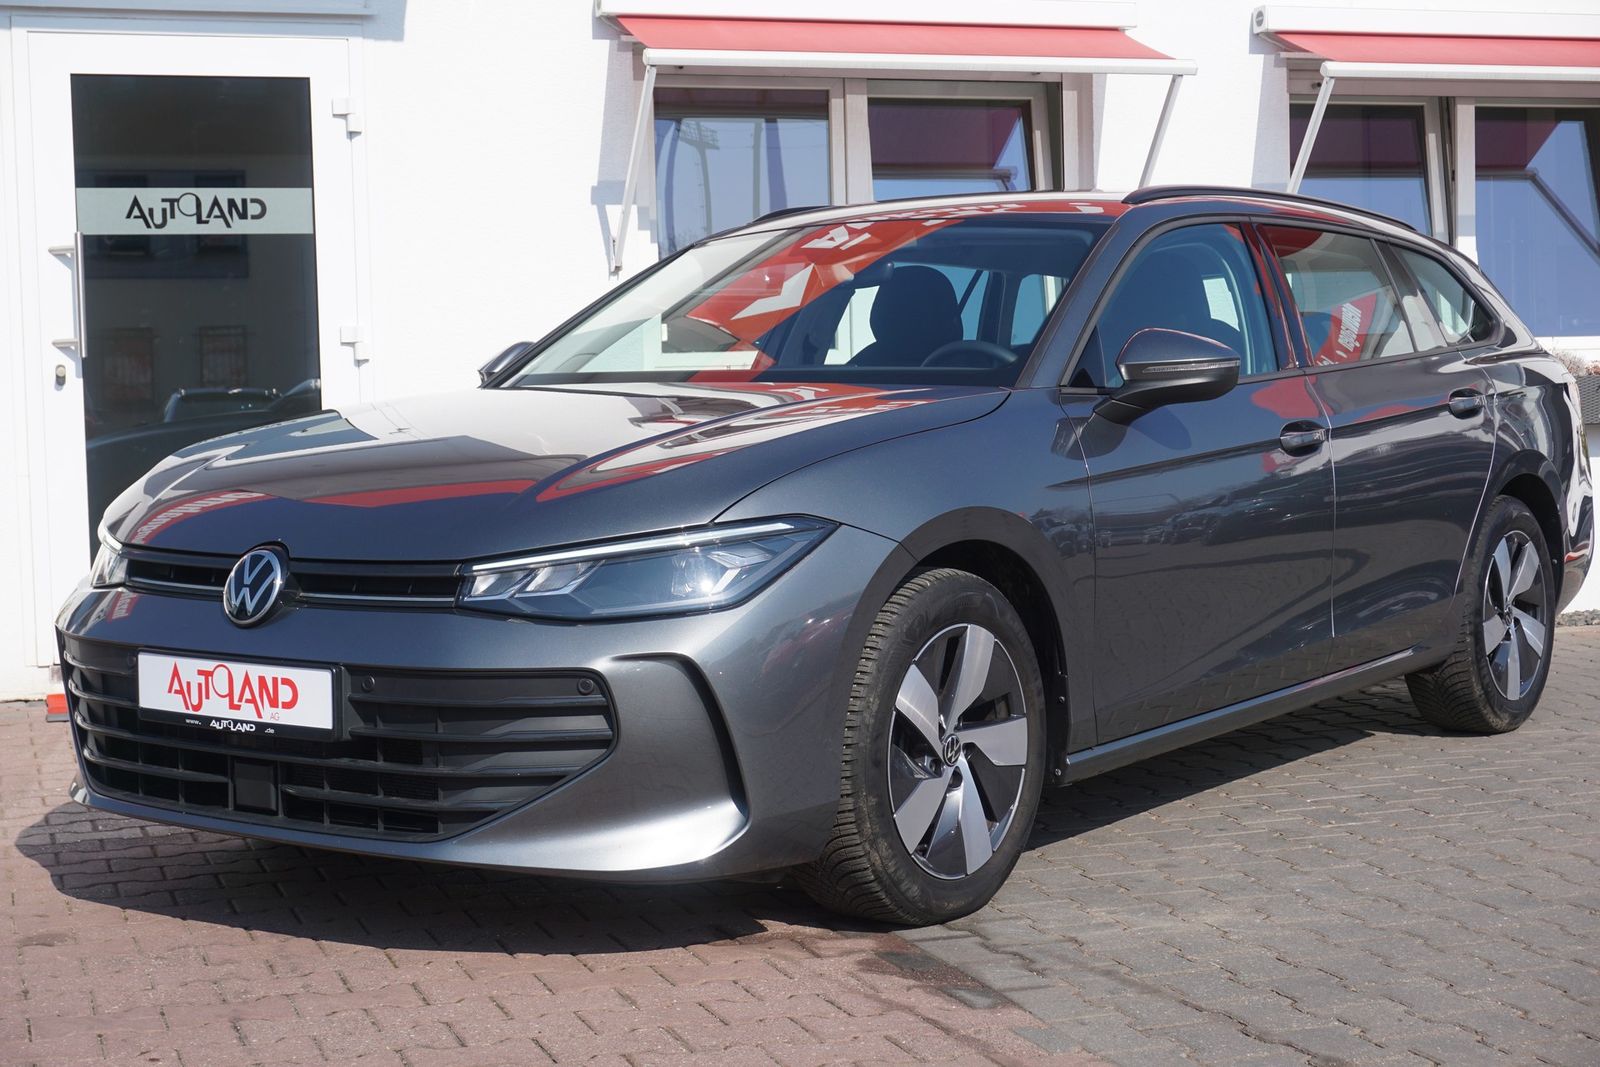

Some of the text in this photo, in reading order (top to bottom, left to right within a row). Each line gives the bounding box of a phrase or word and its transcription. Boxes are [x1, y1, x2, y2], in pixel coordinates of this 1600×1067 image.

[125, 192, 267, 229] AUTOLAND
[167, 661, 299, 719] AUTOLAND
[210, 719, 256, 733] AUTOLAND
